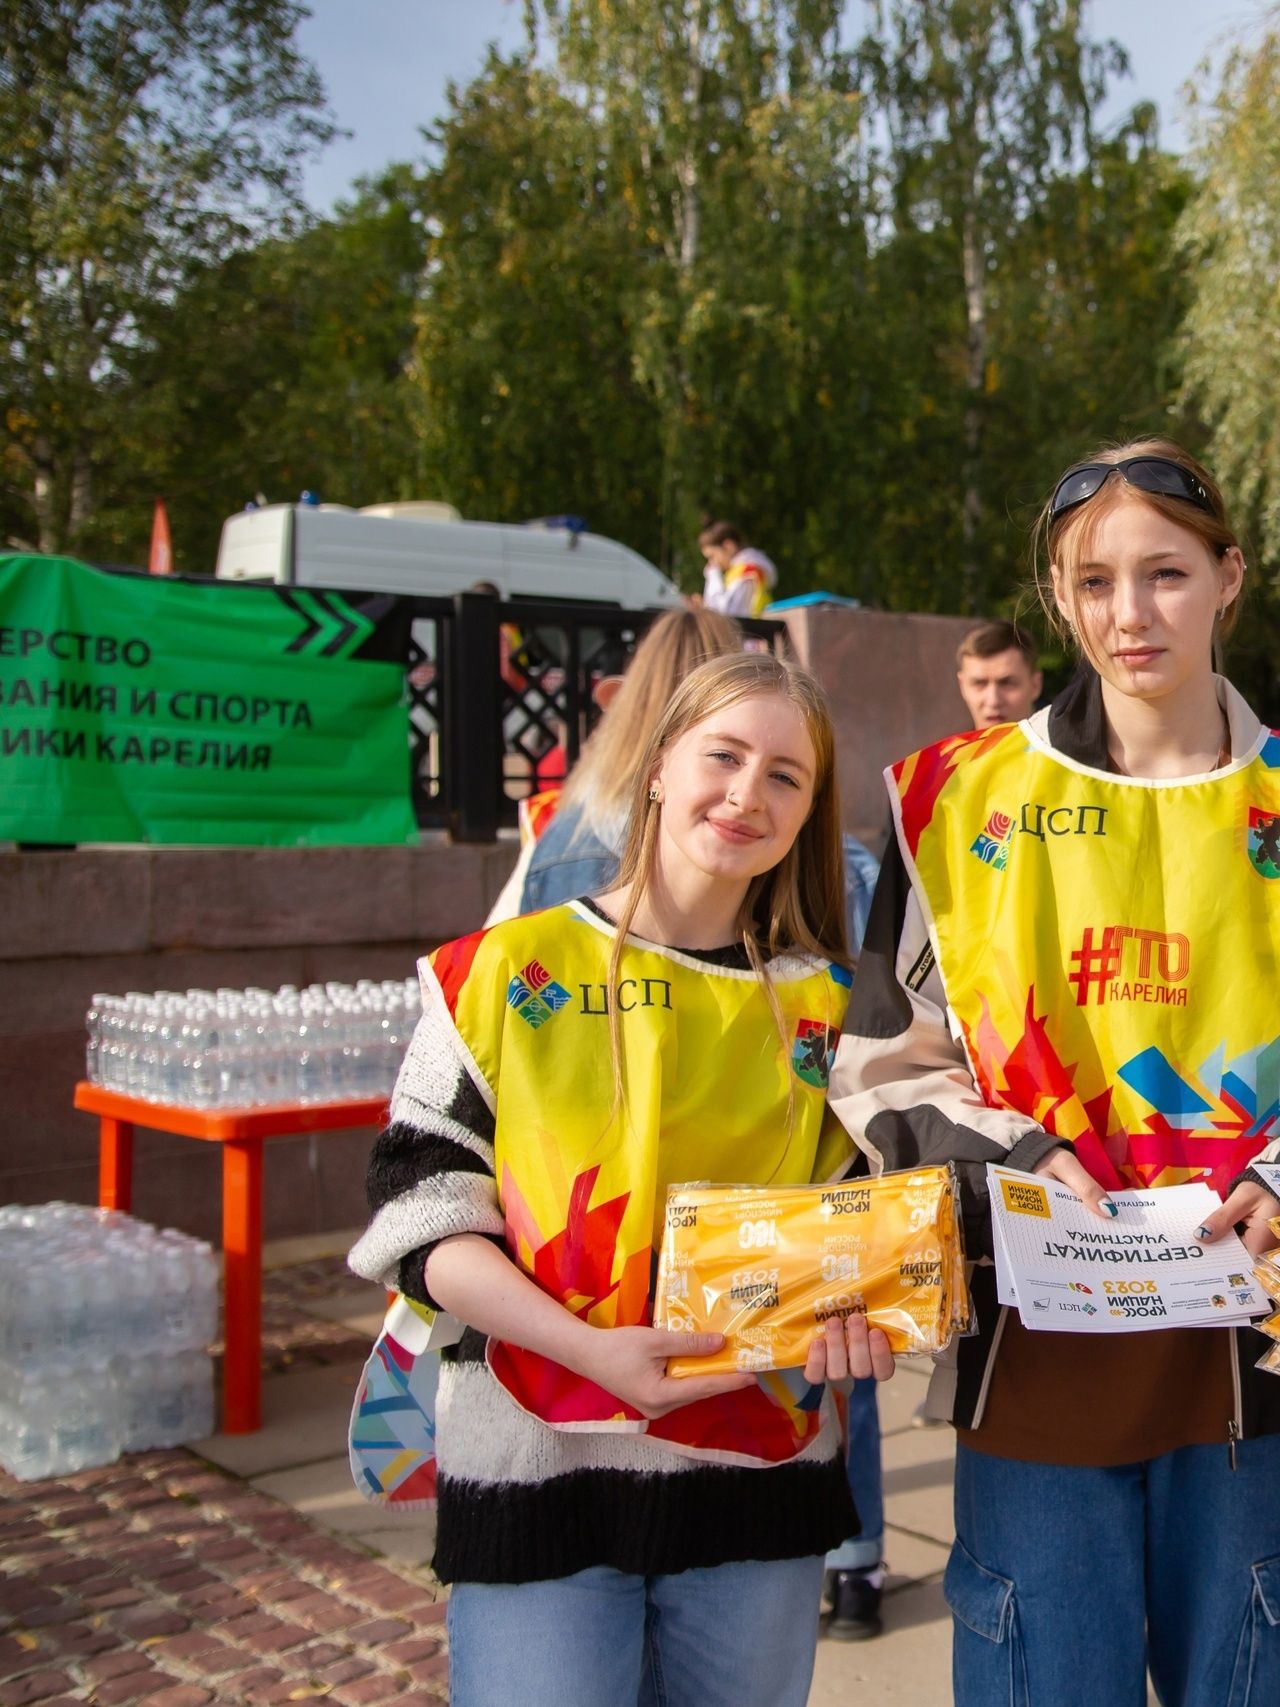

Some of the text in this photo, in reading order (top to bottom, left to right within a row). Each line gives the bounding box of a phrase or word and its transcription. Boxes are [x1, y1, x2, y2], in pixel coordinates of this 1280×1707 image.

[130, 688, 157, 717] И
[168, 691, 313, 730] СПОРТА
[96, 733, 272, 772] КАРЕЛИЯ
[1018, 803, 1108, 842] ЦСП
[578, 978, 673, 1015] ЦСП
[1109, 983, 1188, 1007] КАРЕЛИЯ
[822, 1189, 871, 1203] НАЦИИ
[1008, 1185, 1040, 1197] ЖИЗНИ
[1010, 1192, 1042, 1203] НОРМА
[832, 1202, 871, 1215] КРОСС
[1017, 1200, 1044, 1211] СПОРТ
[1066, 1229, 1168, 1244] УЧАСТНИКА
[1044, 1241, 1204, 1263] СЕРТИФИКАТ
[731, 1268, 780, 1286] 2023
[730, 1282, 779, 1299] НАЦИИ
[1102, 1280, 1158, 1294] 2023
[815, 1292, 864, 1313] 2023
[1059, 1303, 1081, 1312] ЦСП
[1107, 1295, 1163, 1307] НАЦИИ
[1125, 1305, 1167, 1317] КРОСС
